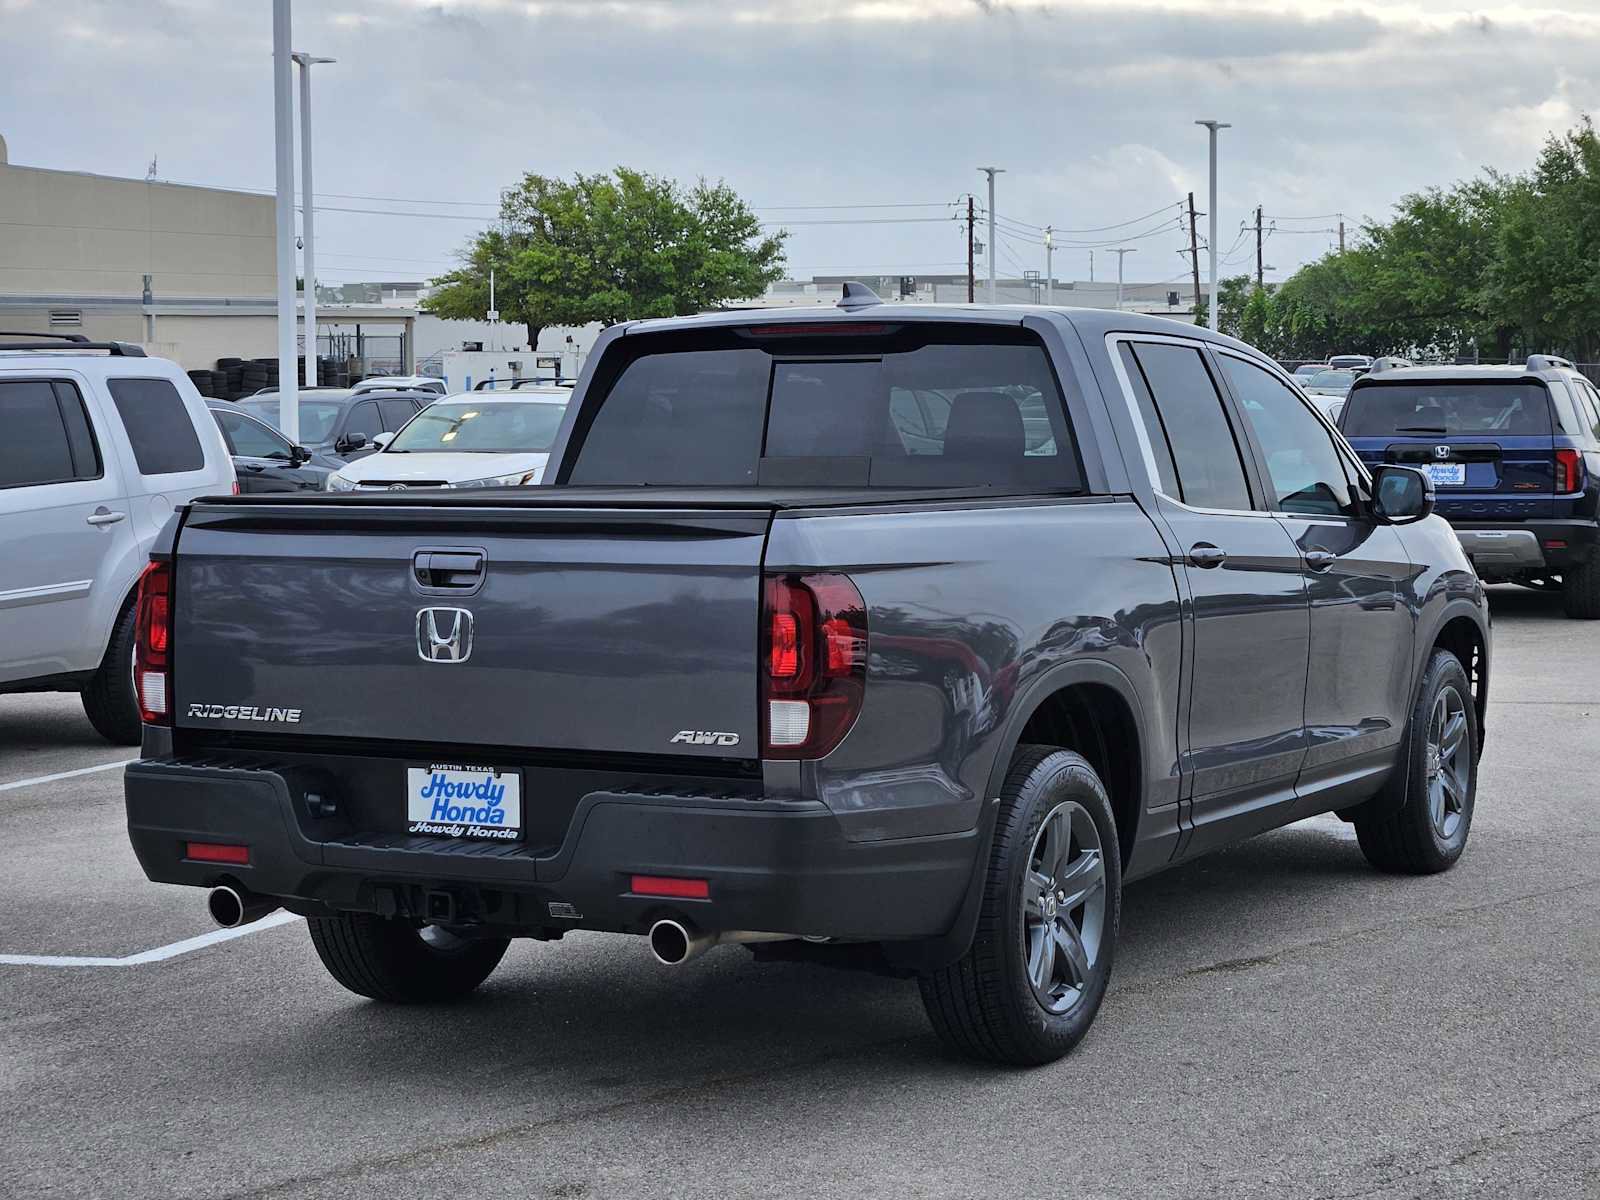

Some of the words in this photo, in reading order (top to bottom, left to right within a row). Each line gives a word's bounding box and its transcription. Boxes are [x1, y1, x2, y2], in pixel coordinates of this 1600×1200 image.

[188, 703, 302, 723] RIDGELINE
[670, 730, 740, 746] AWD
[430, 763, 462, 771] AUSTIN
[465, 765, 494, 773] TEXAS
[421, 773, 505, 807] Howdy
[430, 798, 505, 824] Honda
[409, 822, 465, 837] Howdy
[466, 825, 518, 839] Honda
